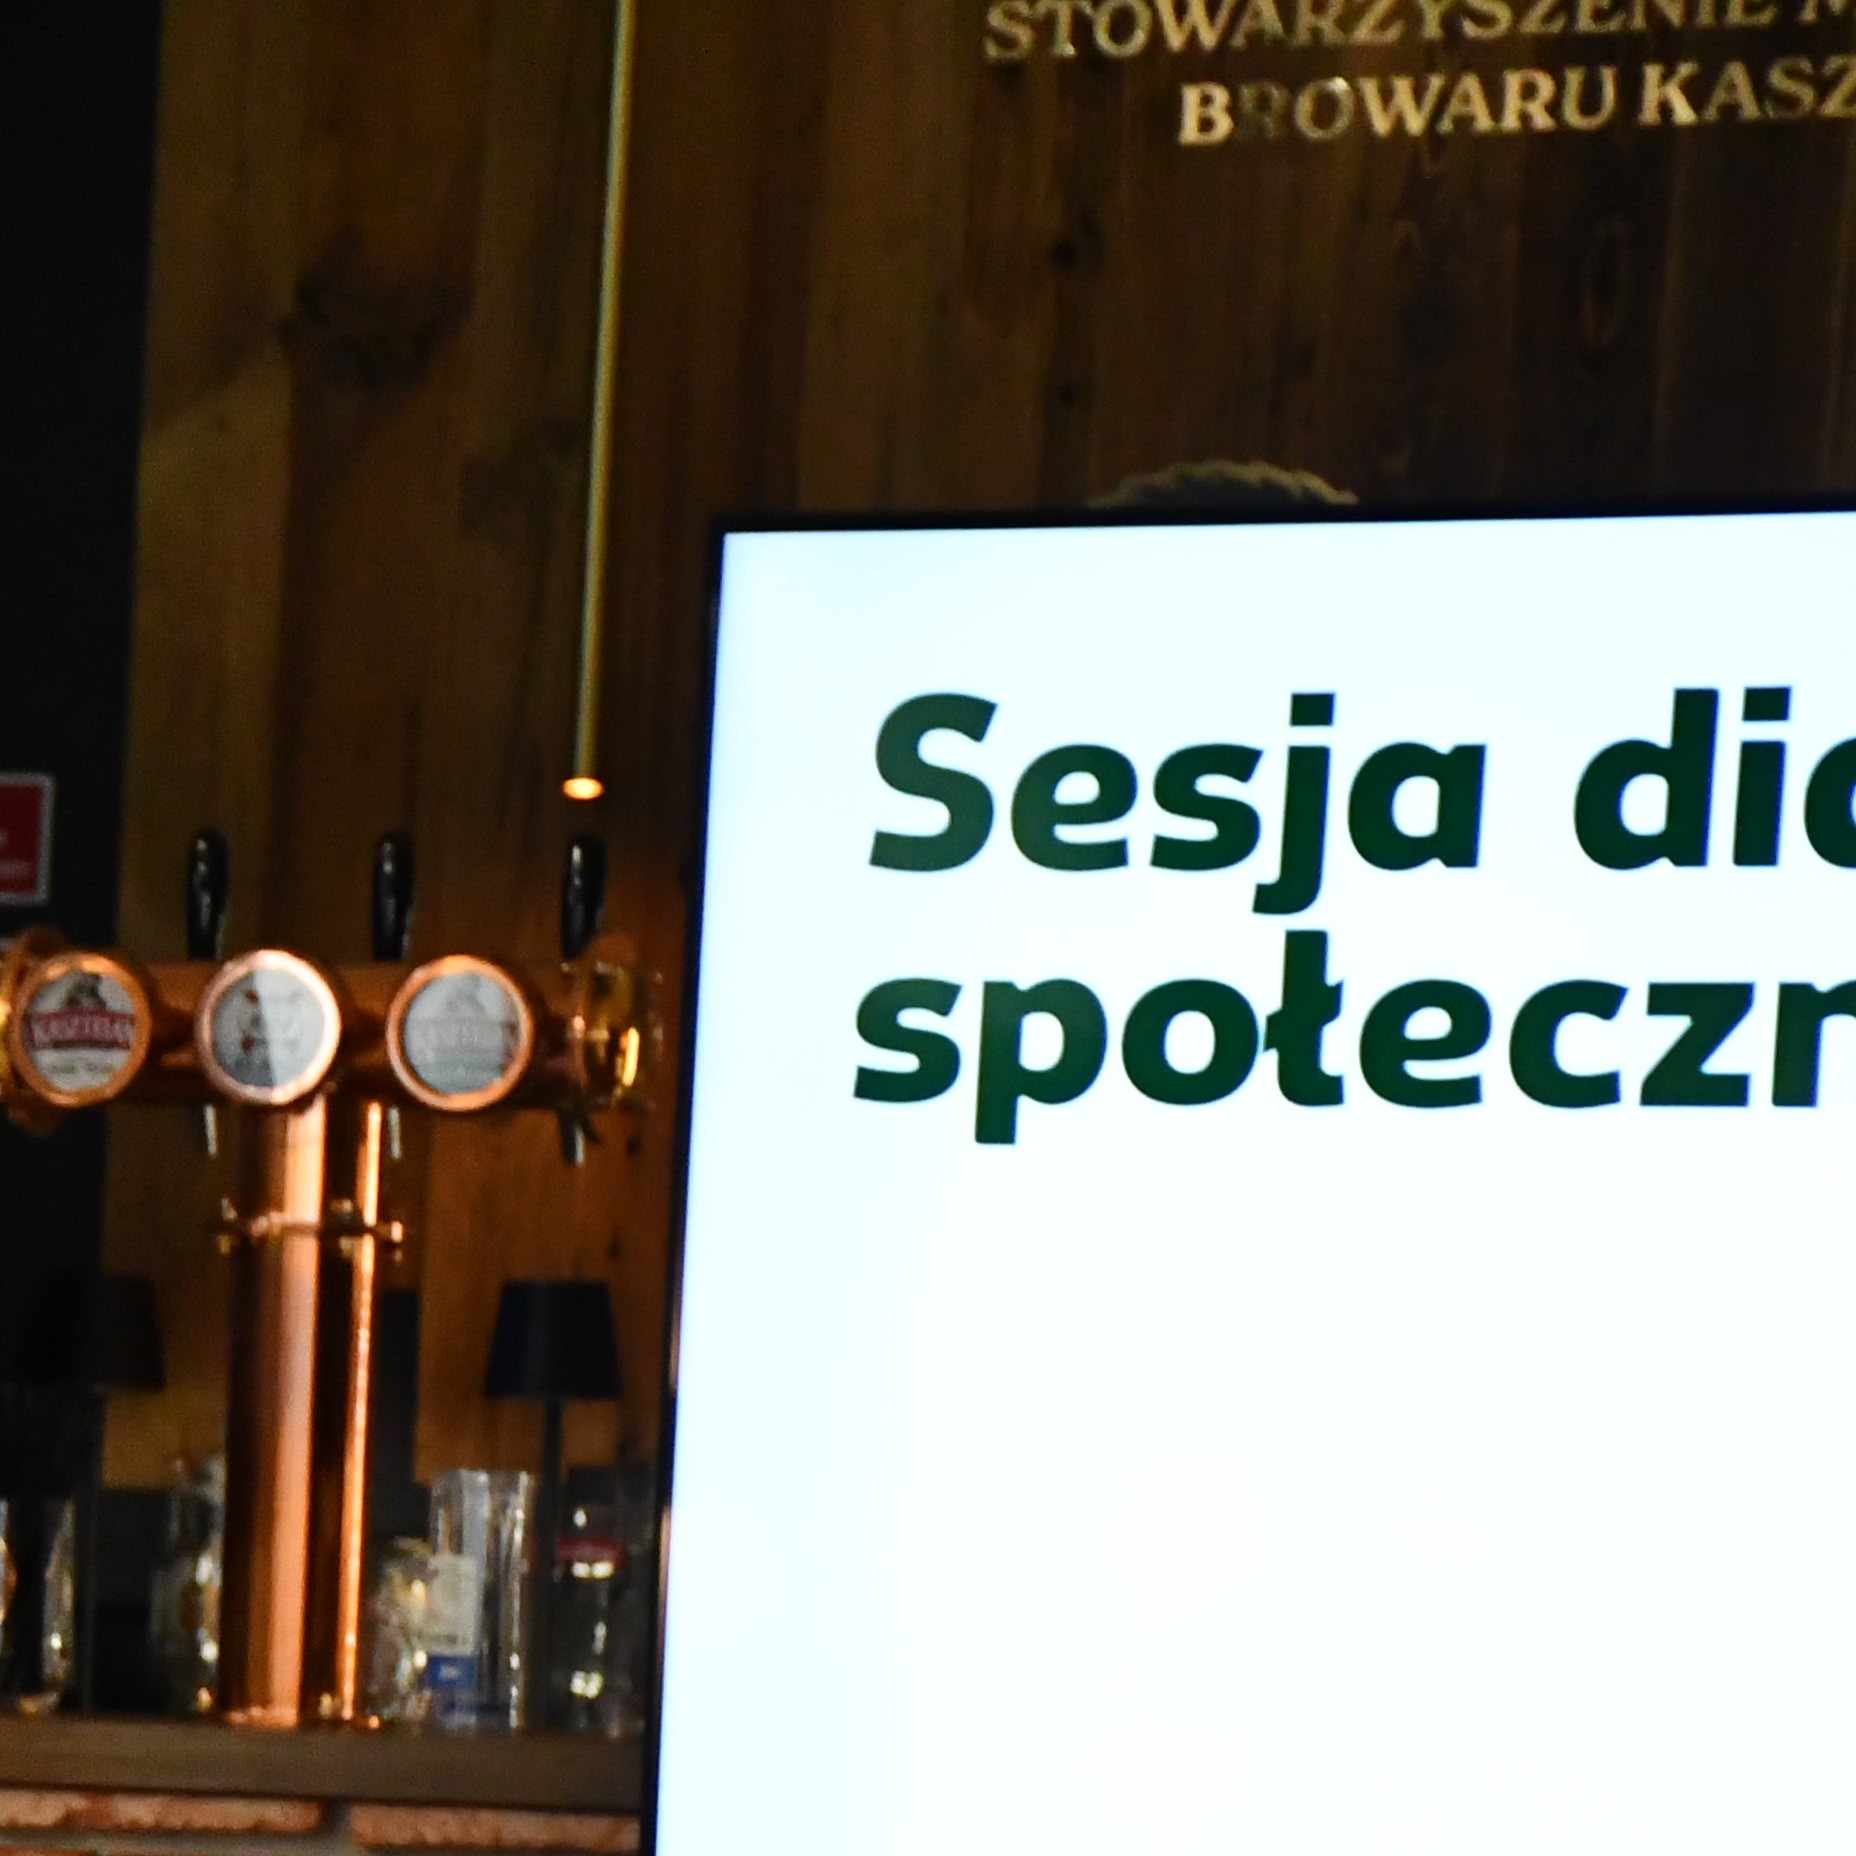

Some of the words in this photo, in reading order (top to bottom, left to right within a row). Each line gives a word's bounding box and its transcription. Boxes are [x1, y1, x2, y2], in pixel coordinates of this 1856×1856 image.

[1178, 66, 1619, 146] BROWARU
[1638, 54, 1856, 127] KASZ
[869, 691, 1487, 916] Sesja
[853, 929, 1856, 1145] społeczn
